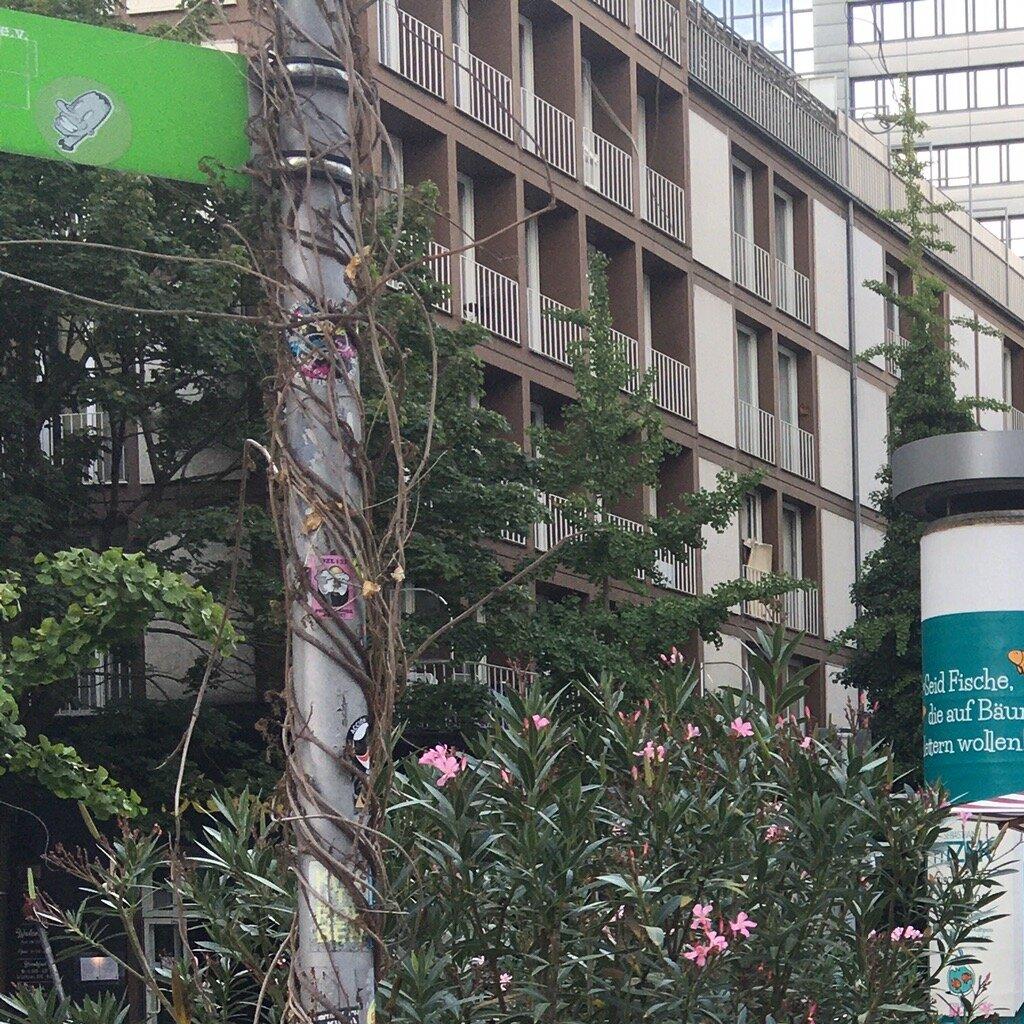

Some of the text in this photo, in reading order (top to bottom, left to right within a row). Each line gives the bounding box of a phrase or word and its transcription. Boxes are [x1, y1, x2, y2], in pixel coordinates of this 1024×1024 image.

[949, 669, 1014, 692] Fische,
[928, 703, 944, 725] die
[946, 699, 975, 723] auf
